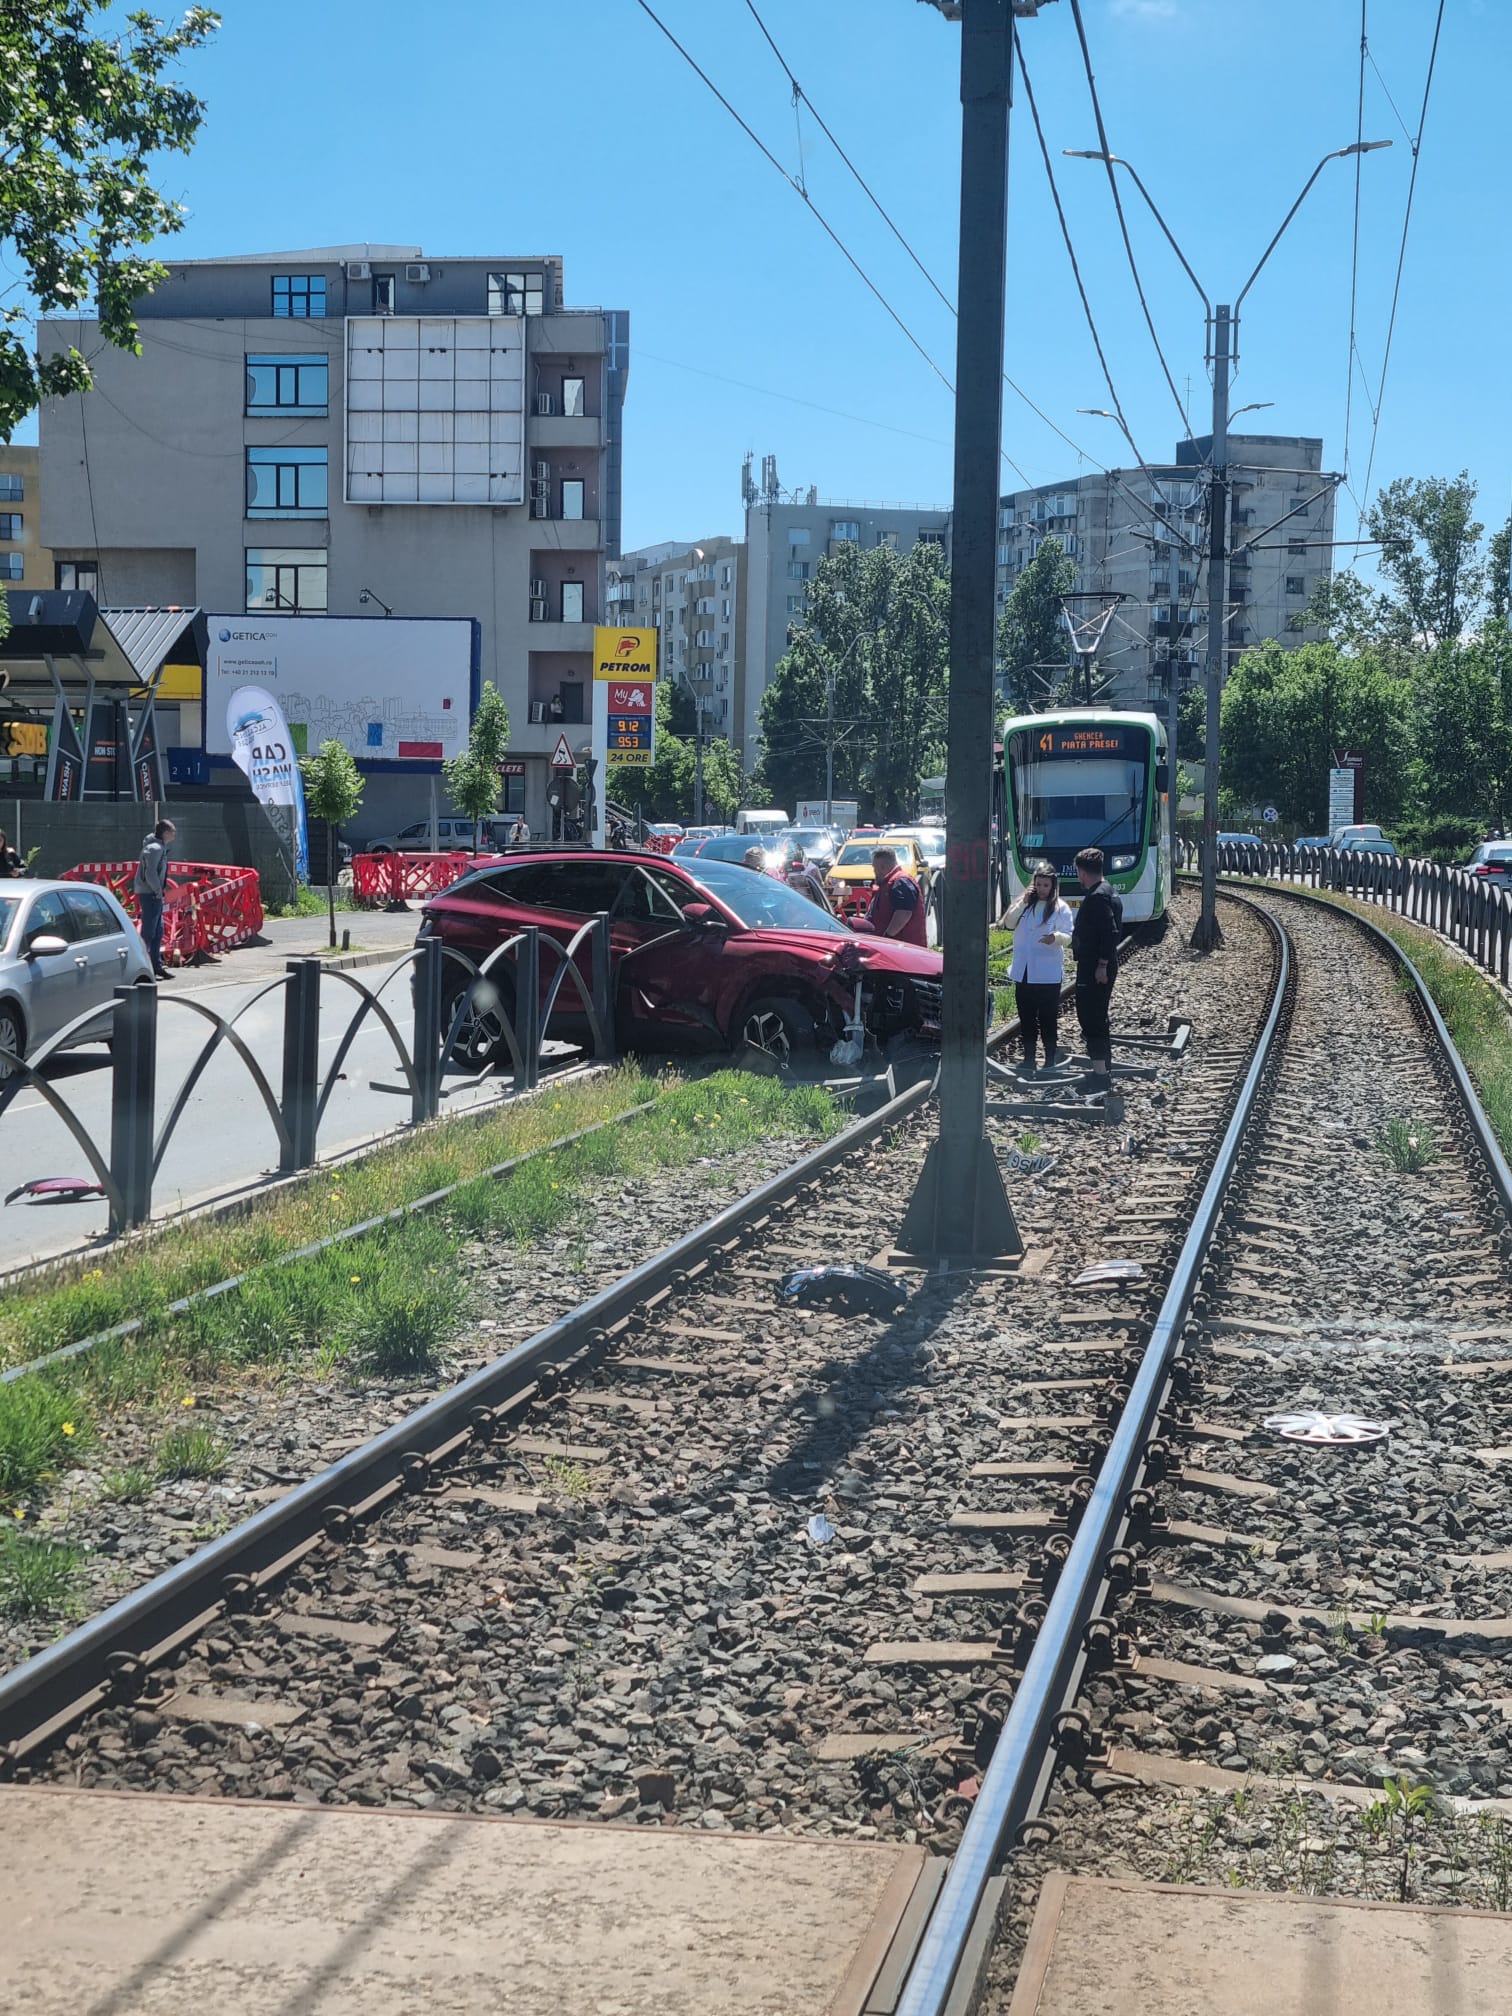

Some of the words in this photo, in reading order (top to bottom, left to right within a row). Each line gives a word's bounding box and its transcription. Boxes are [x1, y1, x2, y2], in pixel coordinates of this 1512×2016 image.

[232, 632, 266, 641] GETICA
[600, 662, 651, 673] PETROM
[1040, 733, 1053, 751] 41
[611, 753, 624, 762] 24
[626, 753, 649, 763] ORE
[61, 761, 71, 797] WASH
